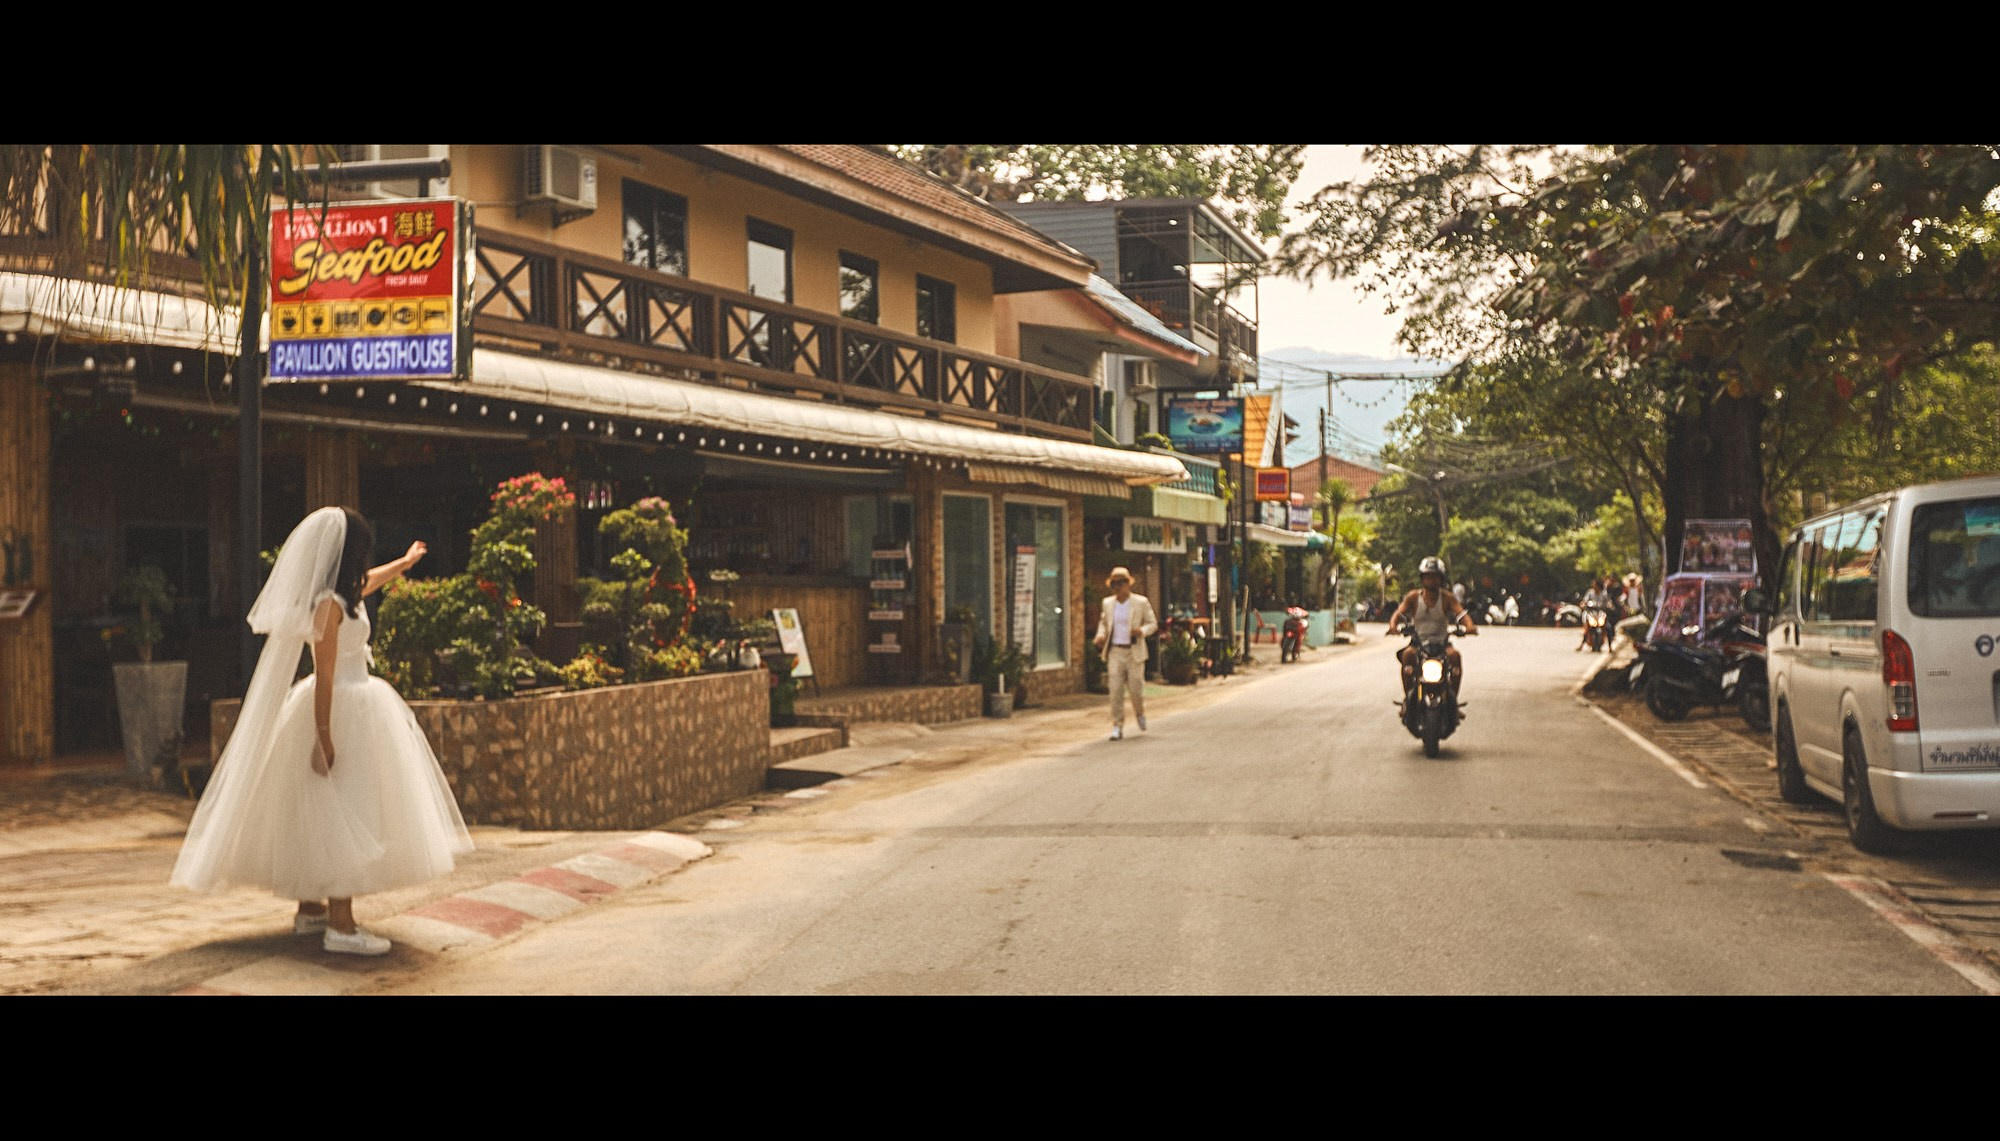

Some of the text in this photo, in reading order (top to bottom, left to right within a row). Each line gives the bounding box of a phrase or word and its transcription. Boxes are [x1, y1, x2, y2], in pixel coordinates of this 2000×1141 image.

[284, 218, 376, 240] PAVLLION
[279, 229, 447, 294] Seafood
[275, 338, 449, 374] PAVILLION GUESTHOUSE
